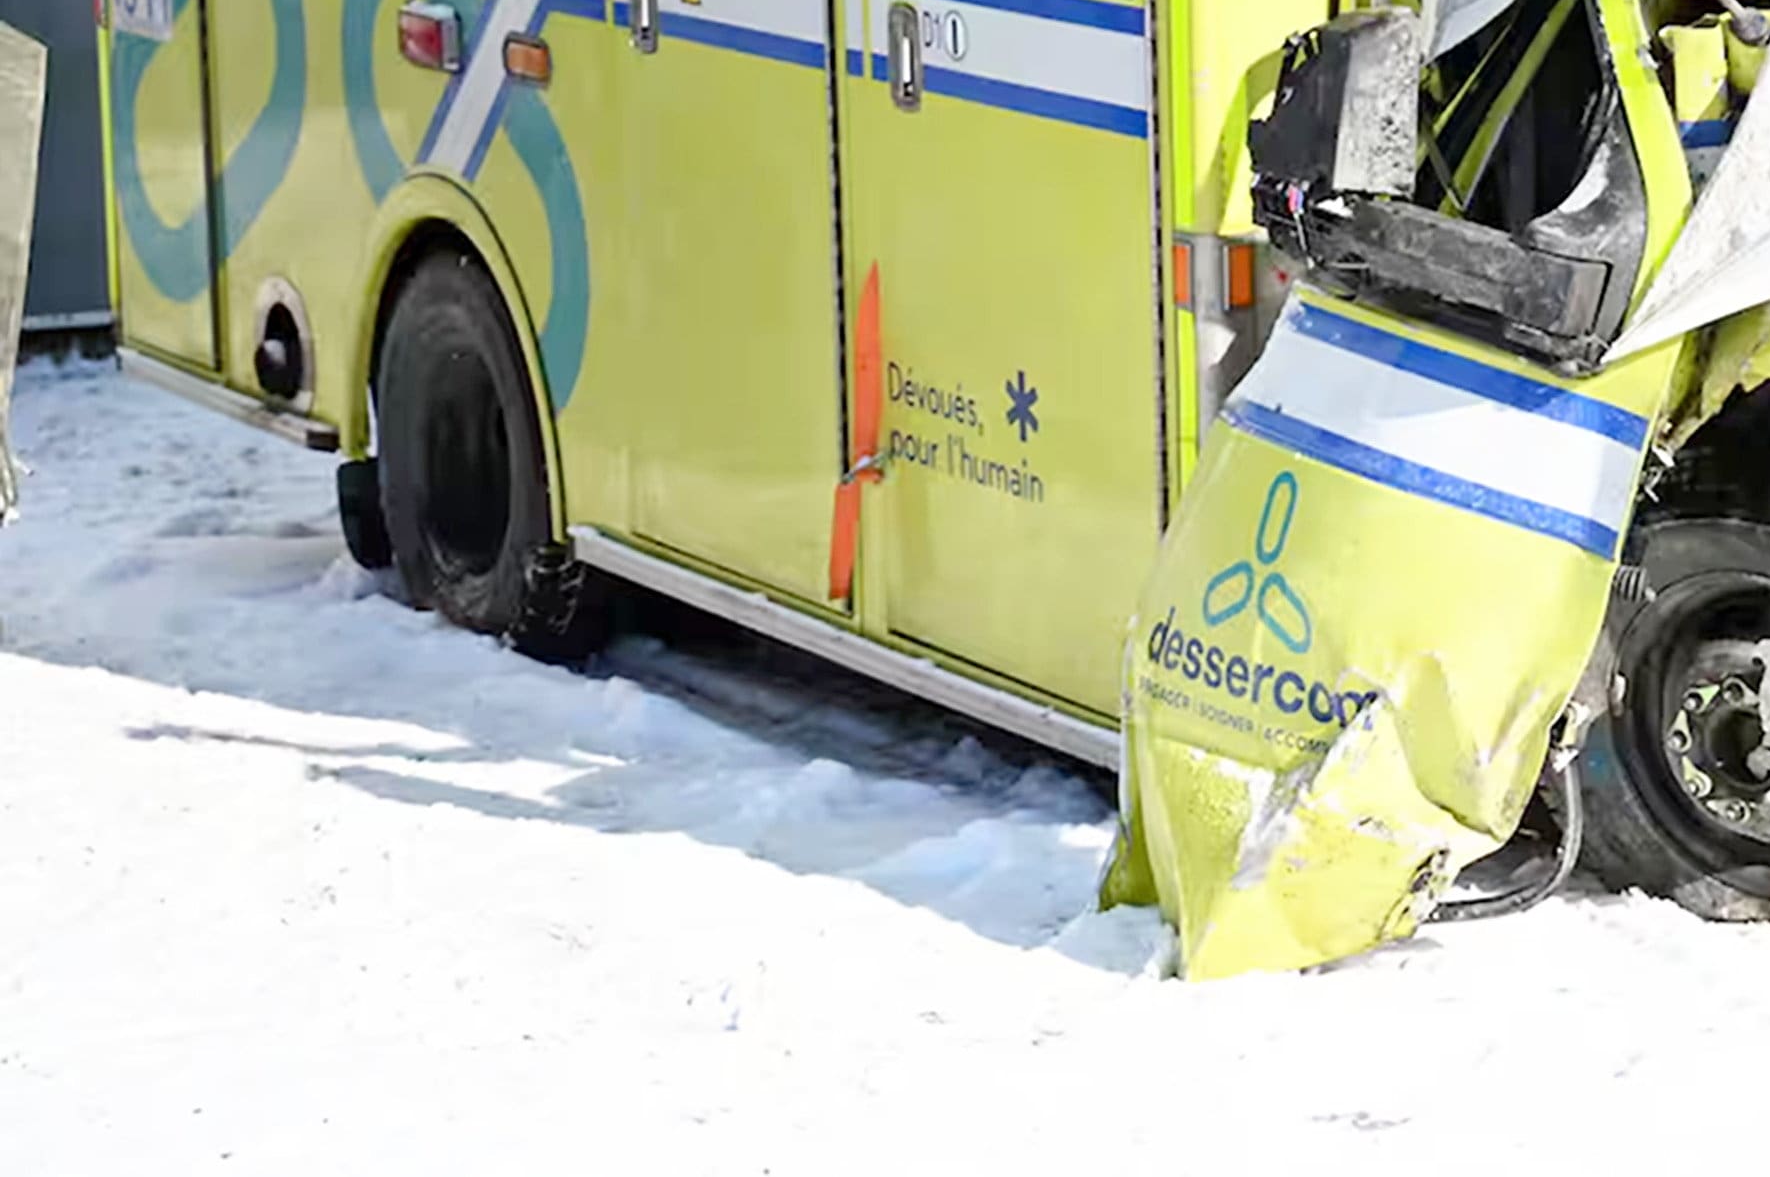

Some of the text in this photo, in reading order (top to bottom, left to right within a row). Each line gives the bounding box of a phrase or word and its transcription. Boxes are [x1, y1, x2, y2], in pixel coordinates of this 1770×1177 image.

[888, 360, 984, 437] Dévoués,
[889, 429, 1044, 503] pour l'humain
